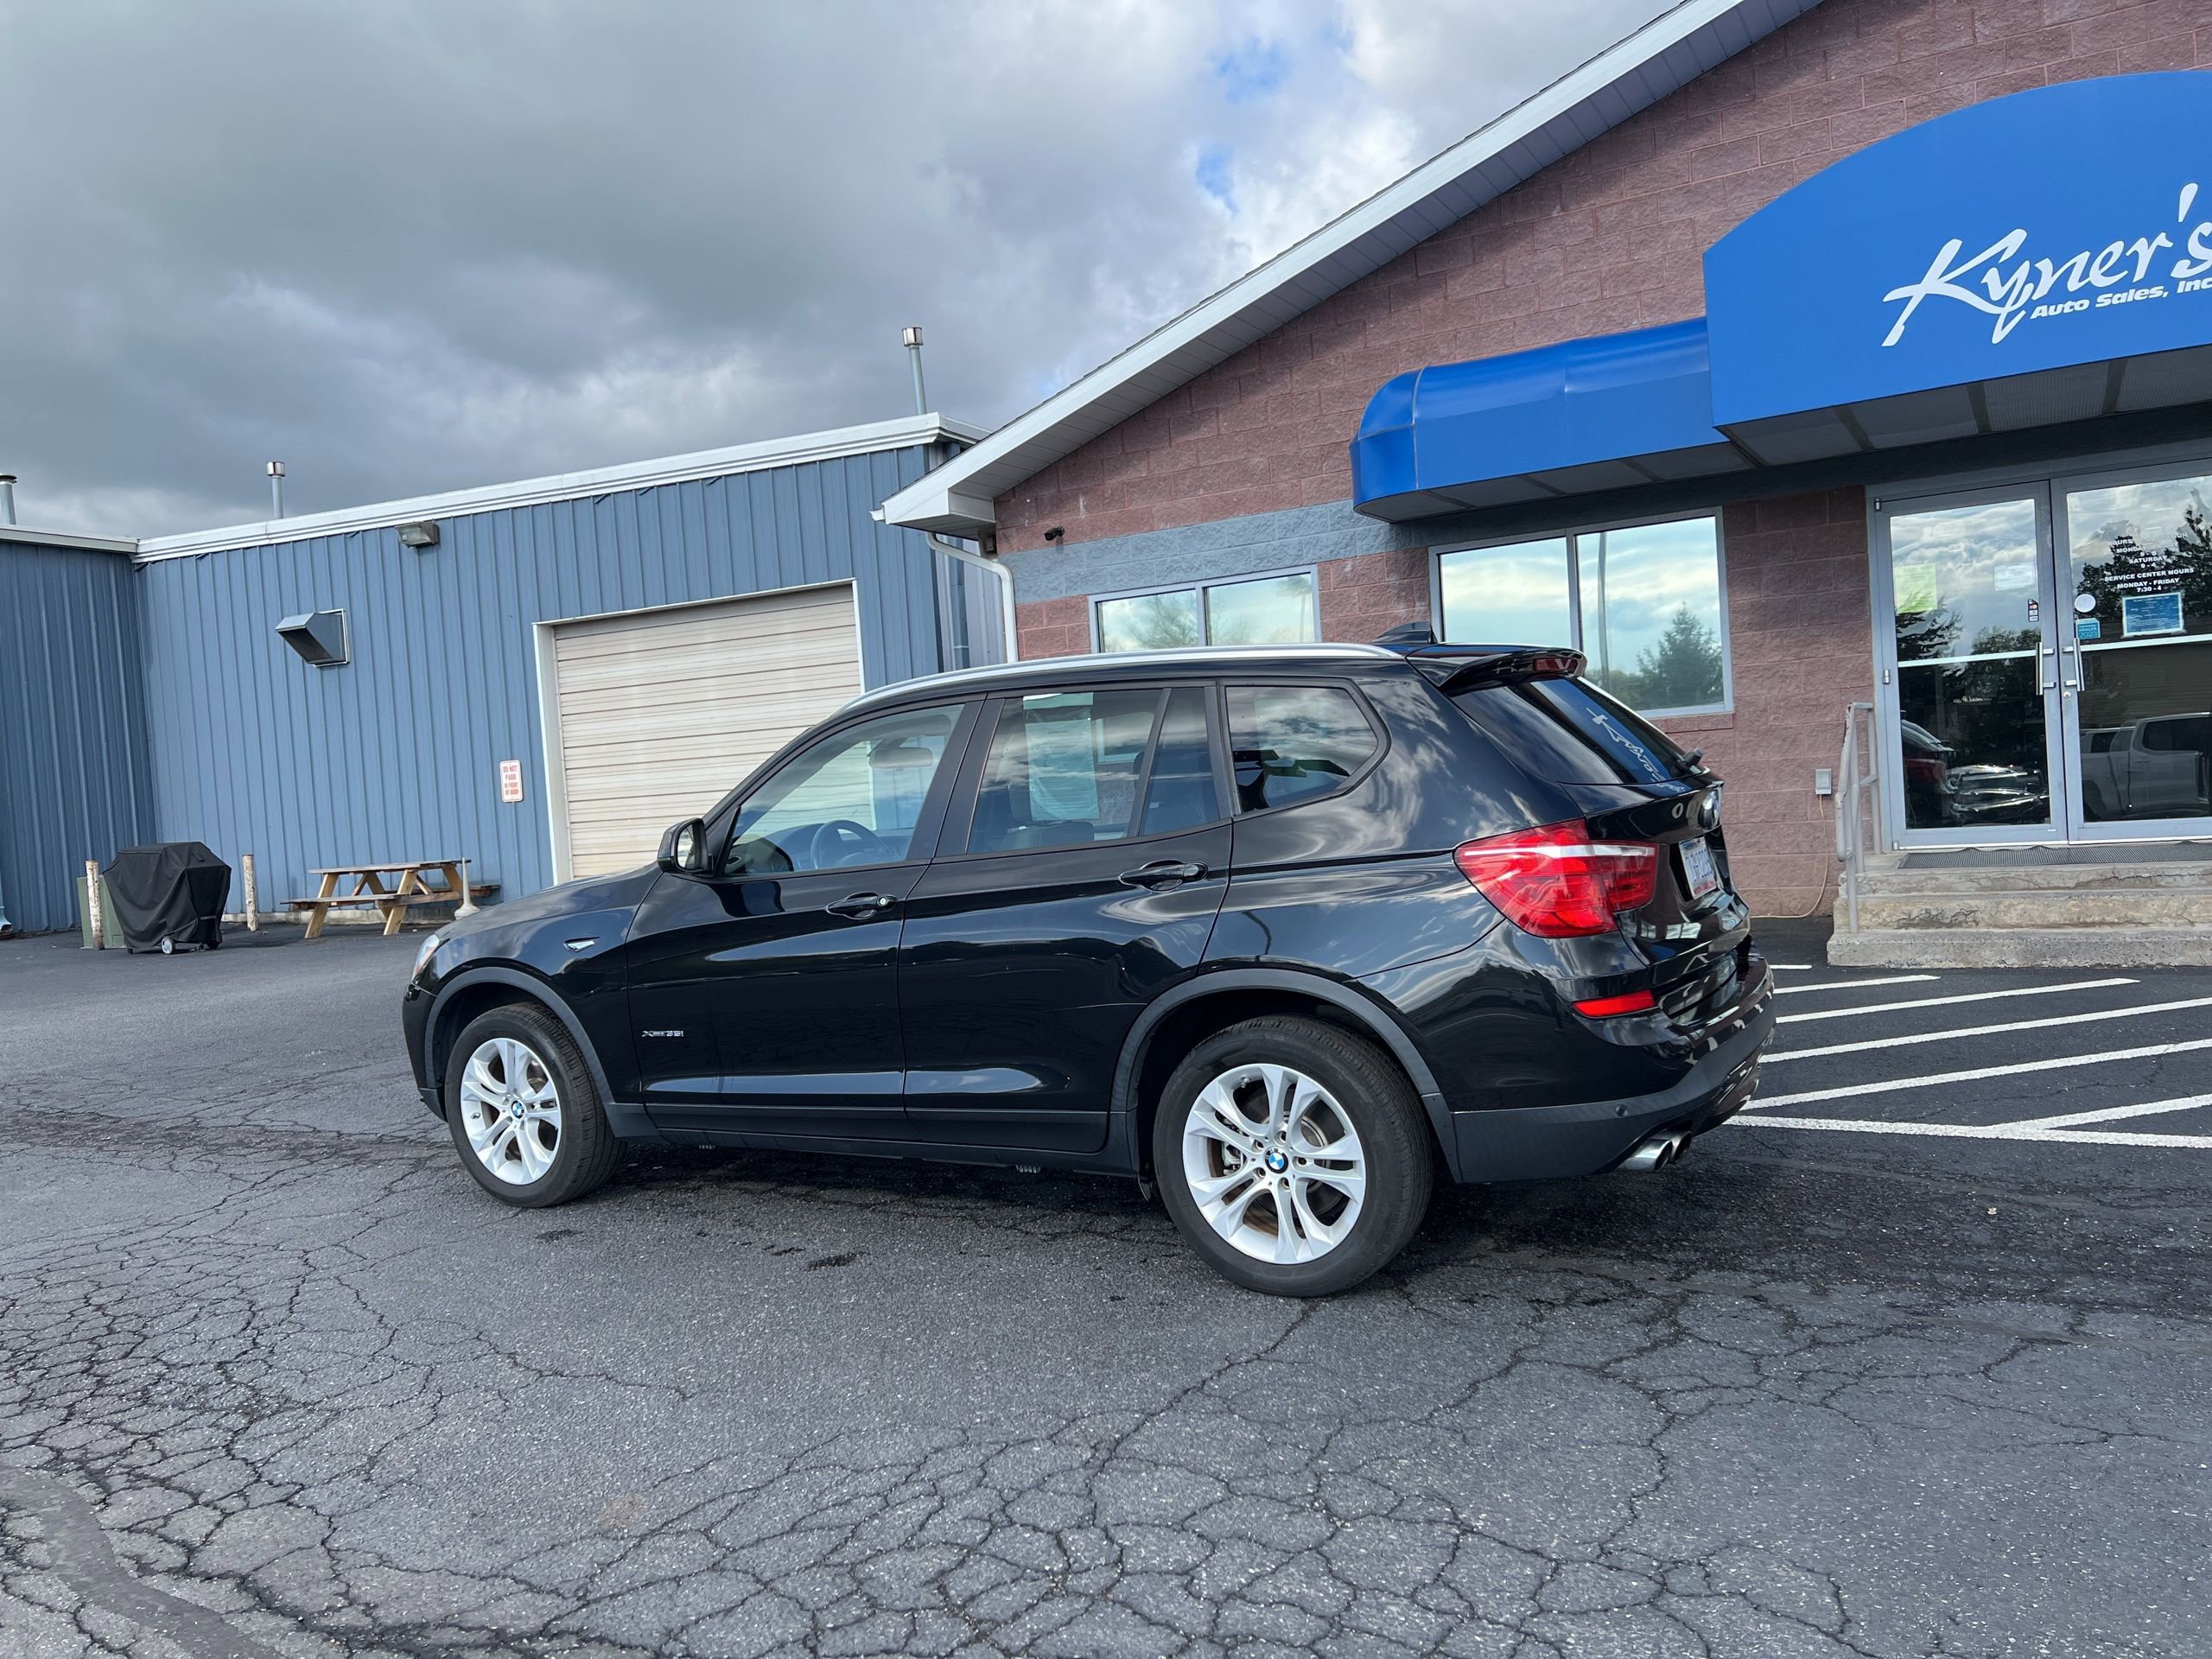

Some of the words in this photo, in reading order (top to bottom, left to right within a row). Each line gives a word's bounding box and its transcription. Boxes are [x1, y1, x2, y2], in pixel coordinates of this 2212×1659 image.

[1881, 183, 2212, 346] Kyner's
[2030, 297, 2090, 320] Auto
[2094, 284, 2169, 308] Sales,
[2128, 555, 2168, 564] SATURDAY
[2104, 573, 2136, 582] SERVICE
[2137, 570, 2167, 579] CENTER
[2117, 581, 2148, 589] MONDAY
[2153, 577, 2180, 586] FRIDAY
